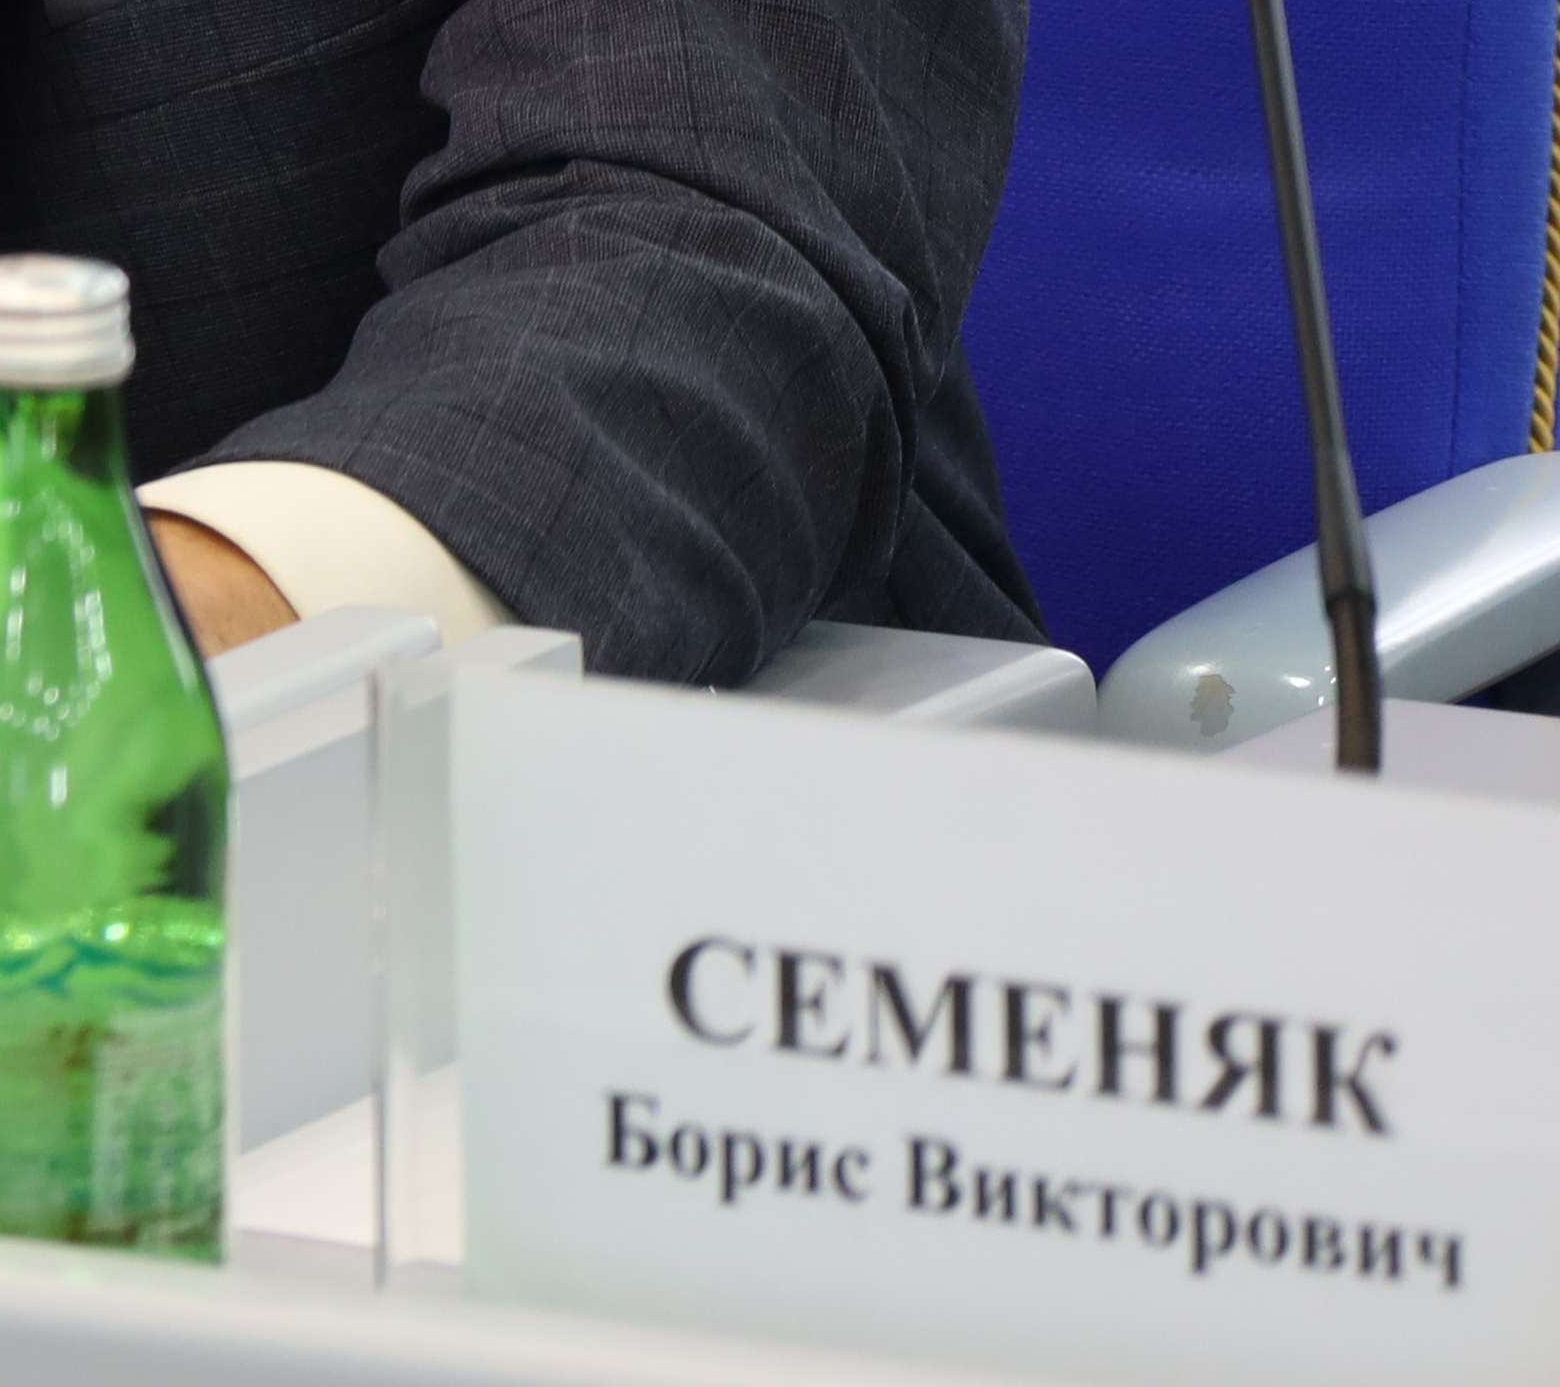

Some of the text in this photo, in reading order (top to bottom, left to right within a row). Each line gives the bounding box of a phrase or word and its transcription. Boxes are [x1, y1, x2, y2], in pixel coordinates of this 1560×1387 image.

[665, 936, 1401, 1138] СЕМЕНЯК
[605, 1091, 1465, 1290] Борис Викторович
